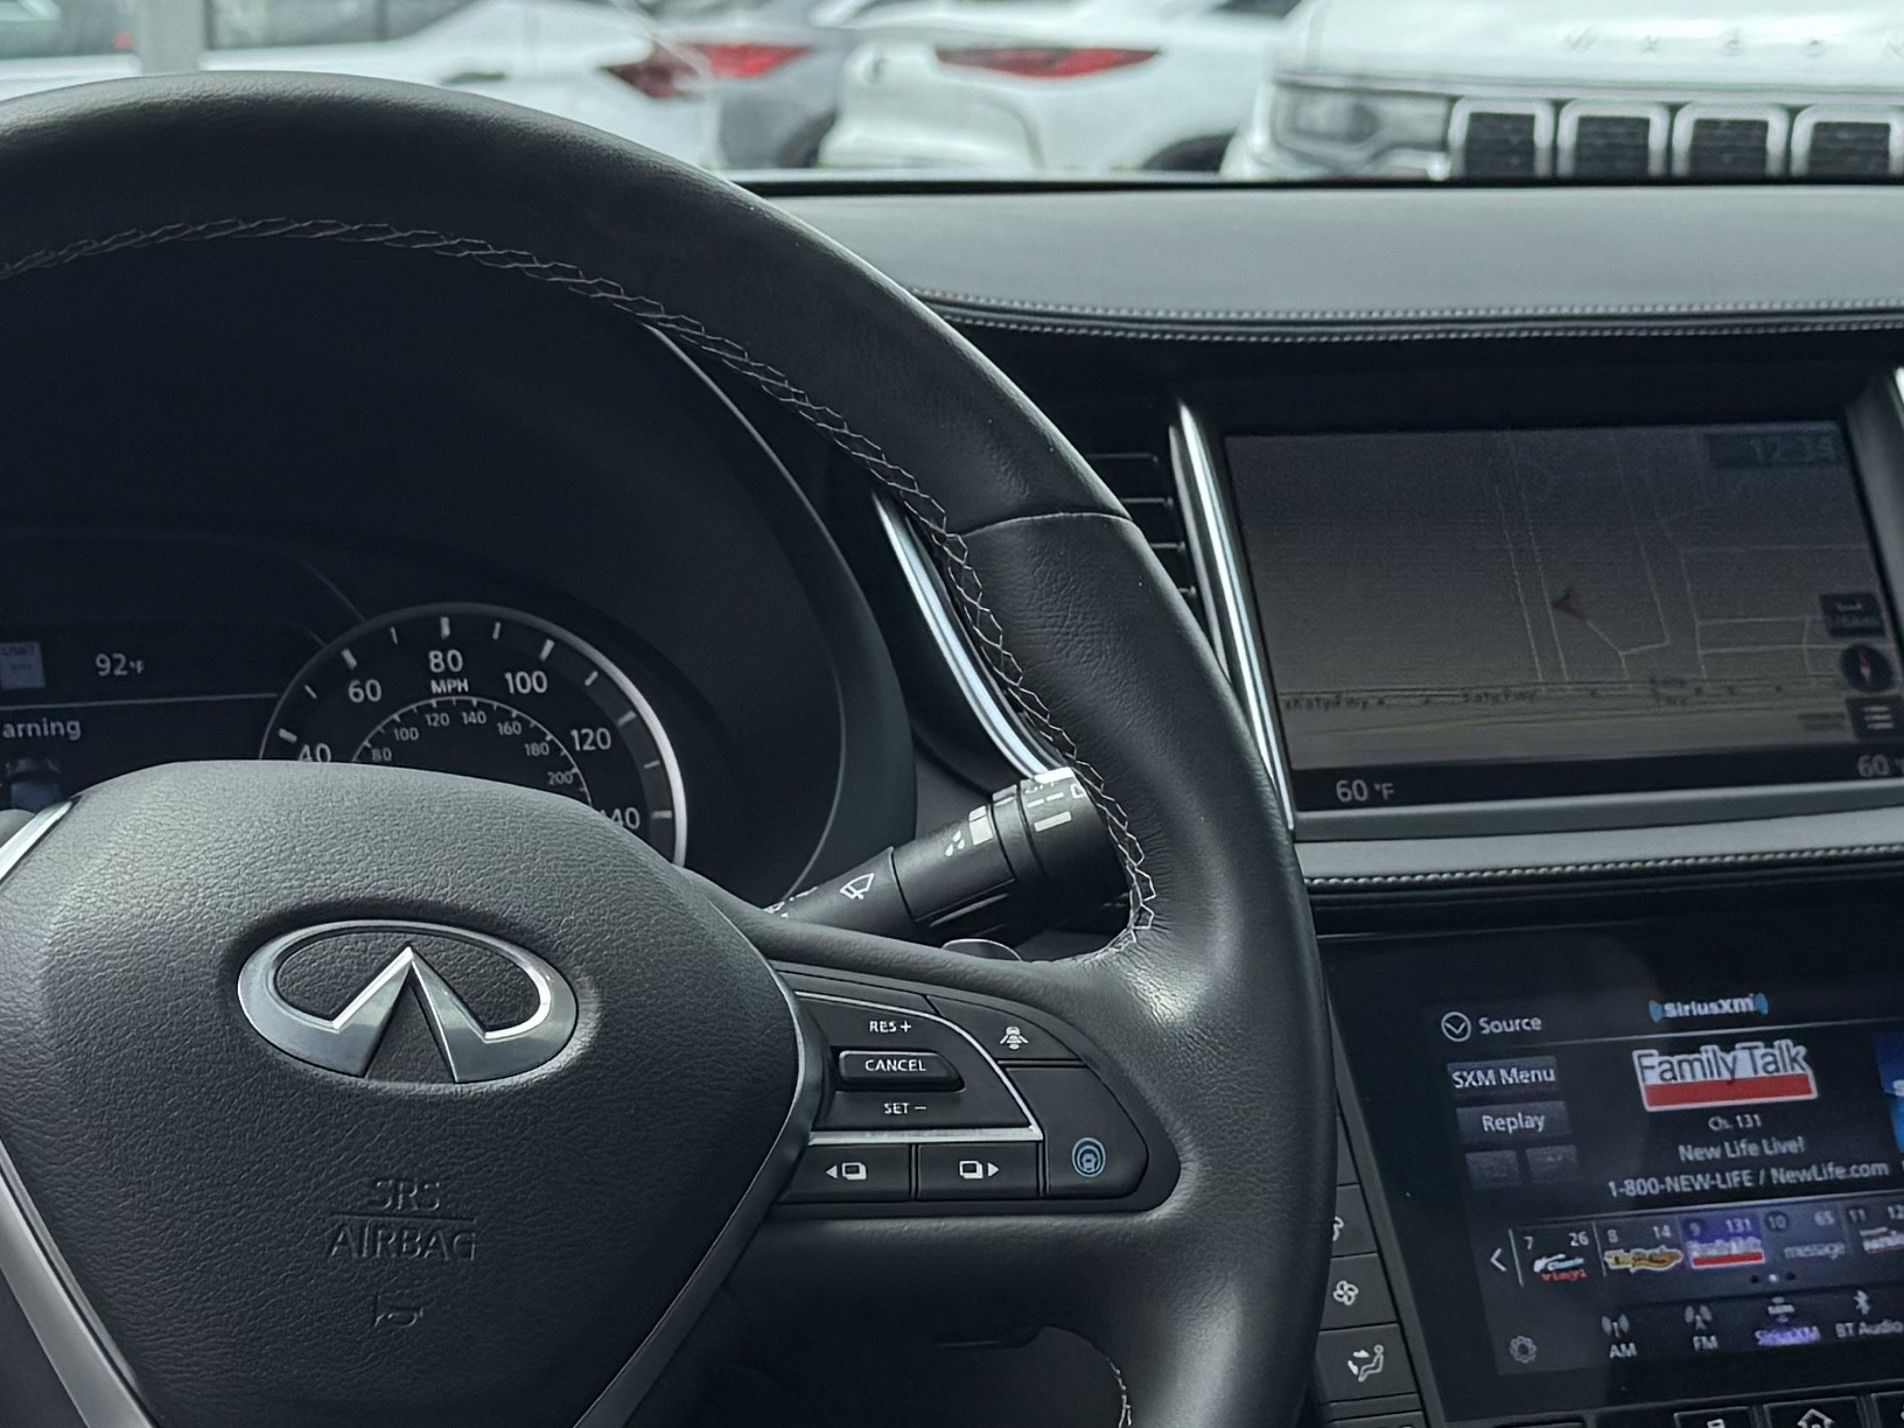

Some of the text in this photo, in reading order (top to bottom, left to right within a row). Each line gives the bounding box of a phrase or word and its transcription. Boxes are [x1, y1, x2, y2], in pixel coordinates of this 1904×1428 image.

[428, 649, 463, 673] 80
[348, 679, 382, 704] 60
[431, 678, 469, 696] MPH
[504, 670, 548, 695] 100
[425, 711, 451, 729] 120
[462, 710, 487, 726] 140
[393, 725, 420, 742] 100
[497, 719, 523, 736] 160
[524, 740, 550, 757] 180
[569, 727, 613, 752] 120
[1857, 754, 1890, 778] 60
[547, 769, 575, 786] 200
[1335, 778, 1369, 803] 60
[869, 1020, 897, 1034] RES
[1478, 1015, 1543, 1035] Source
[864, 1058, 927, 1073] CANCEL
[1450, 1066, 1556, 1089] SXM Menu
[883, 1102, 910, 1115] SET
[1481, 1112, 1546, 1134] Replay
[1736, 1113, 1762, 1130] 131
[1678, 1143, 1721, 1162] New
[1724, 1141, 1760, 1159] Life
[1607, 1169, 1754, 1198] 1-800-NEW-LIFE
[1770, 1162, 1890, 1185] NewLife.com
[1652, 1224, 1673, 1240] 14
[1725, 1217, 1754, 1234] 131
[327, 1225, 478, 1262] AIRBAG
[1568, 1230, 1590, 1248] 26
[1609, 1342, 1637, 1359] AM
[1693, 1335, 1718, 1352] FM
